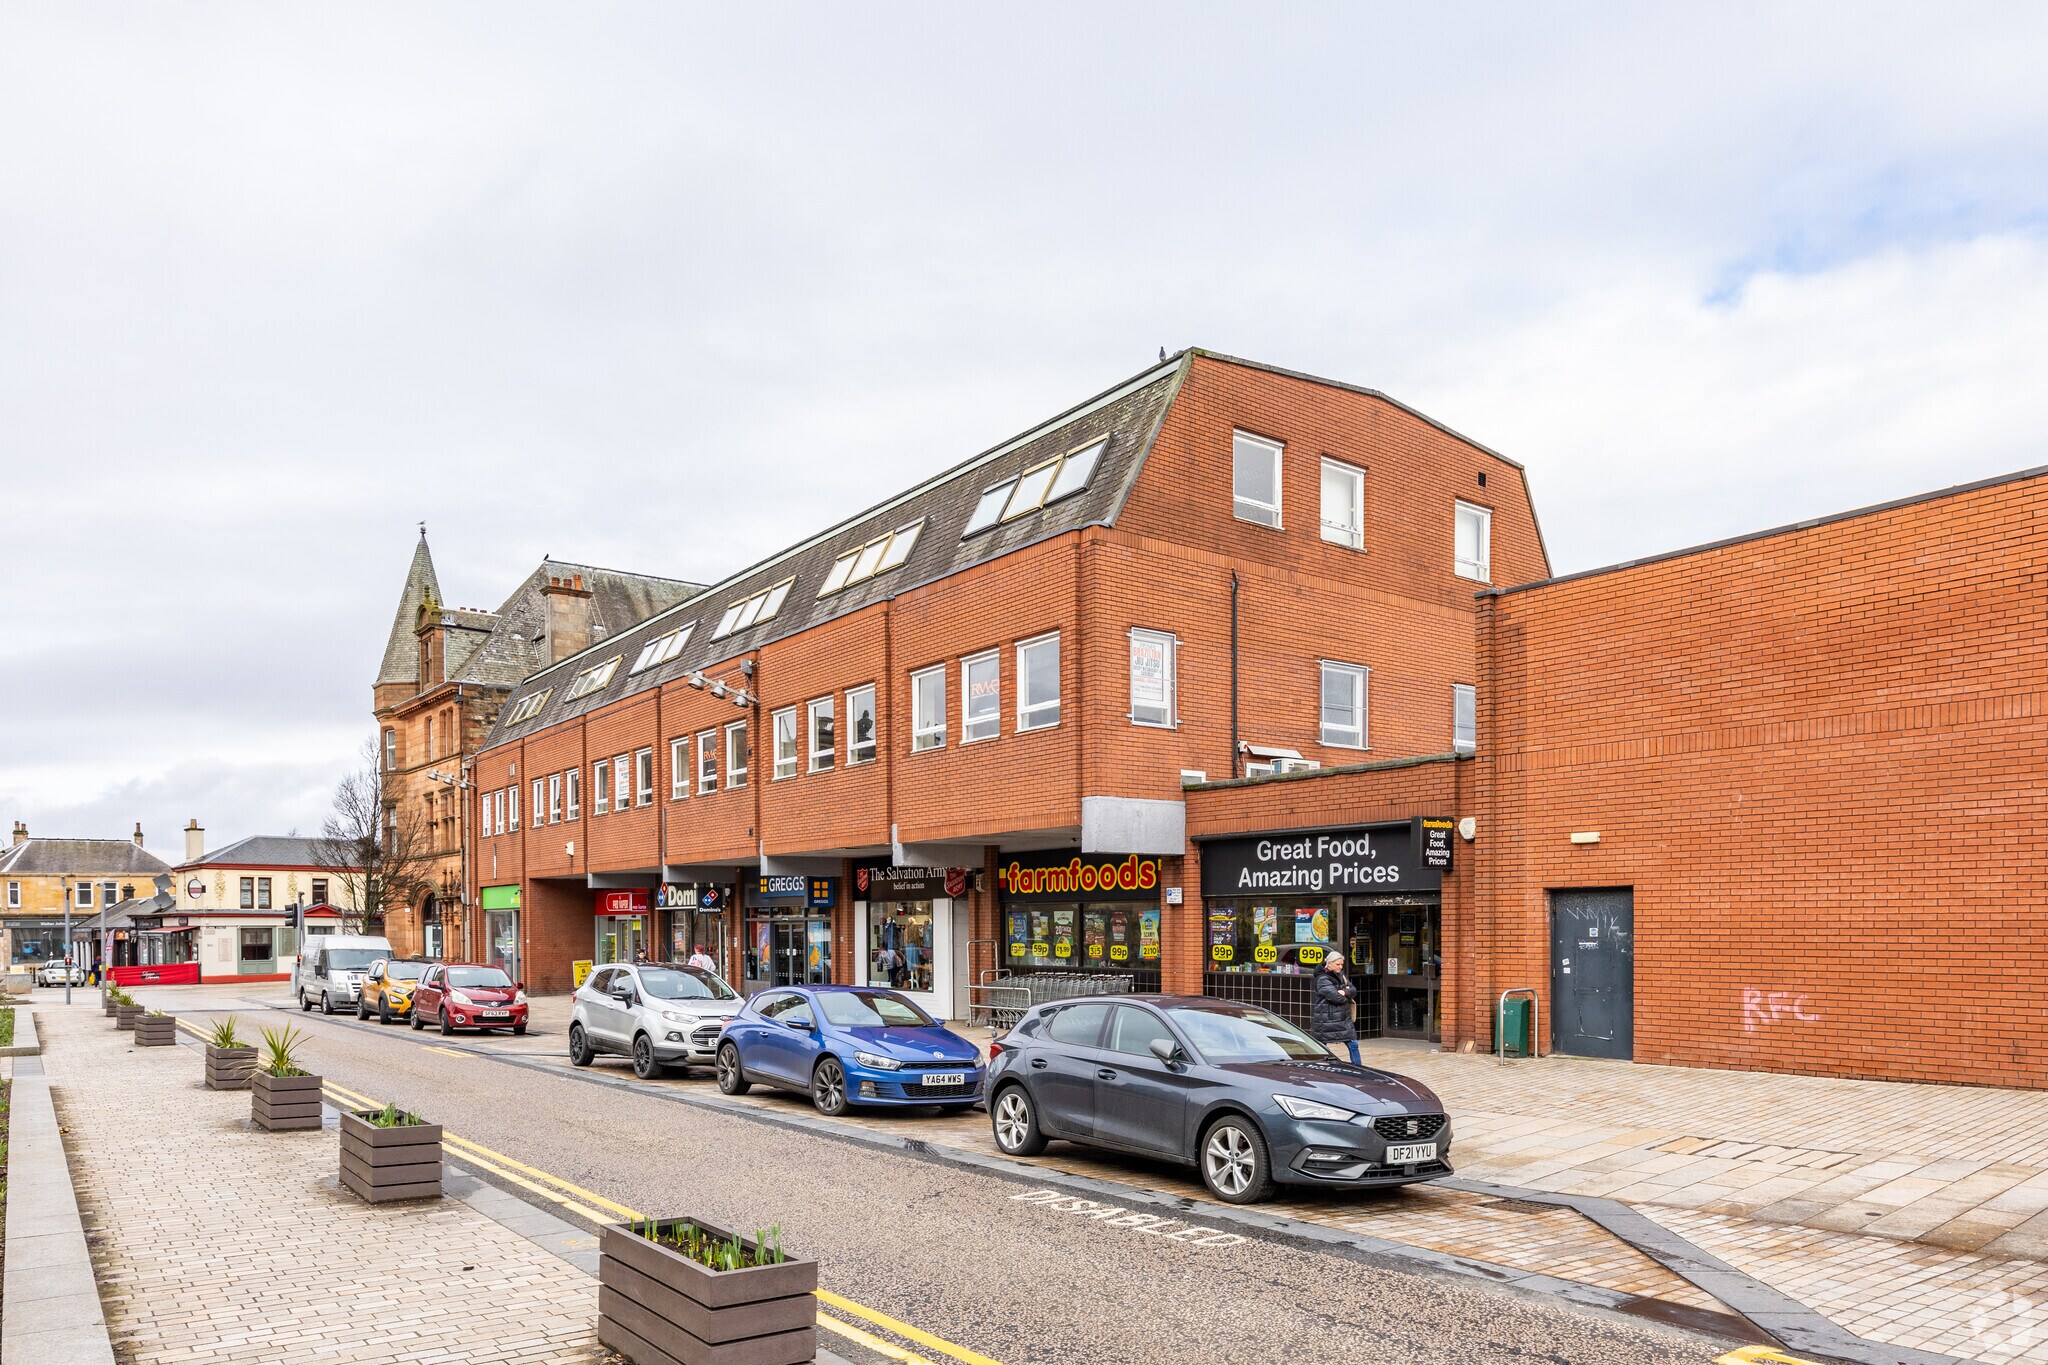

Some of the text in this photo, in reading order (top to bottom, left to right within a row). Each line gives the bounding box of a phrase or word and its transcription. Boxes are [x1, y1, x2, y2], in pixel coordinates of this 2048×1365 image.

[1145, 658, 1160, 668] JITSU
[1423, 819, 1453, 829] farmfoods
[1430, 830, 1446, 839] Great
[1256, 833, 1376, 861] Great Food,
[1430, 839, 1446, 849] Food,
[1425, 848, 1450, 858] Amazing
[1428, 857, 1447, 865] Prices
[870, 868, 884, 881] The
[886, 866, 924, 880] Salvation
[1007, 853, 1156, 894] farmfoods
[1238, 862, 1400, 890] Amazing Prices
[768, 876, 805, 892] GREGGS
[893, 881, 925, 890] belief in action
[1034, 945, 1047, 955] 59p
[1112, 947, 1127, 958] 99p
[1214, 946, 1232, 958] 99p
[1256, 948, 1276, 961] 69p
[1301, 949, 1322, 961] 99p
[1743, 987, 1820, 1034] RFC
[925, 1074, 945, 1084] YA64
[1393, 1145, 1432, 1160] DF21 YYU
[1009, 1189, 1247, 1247] DISABLED
